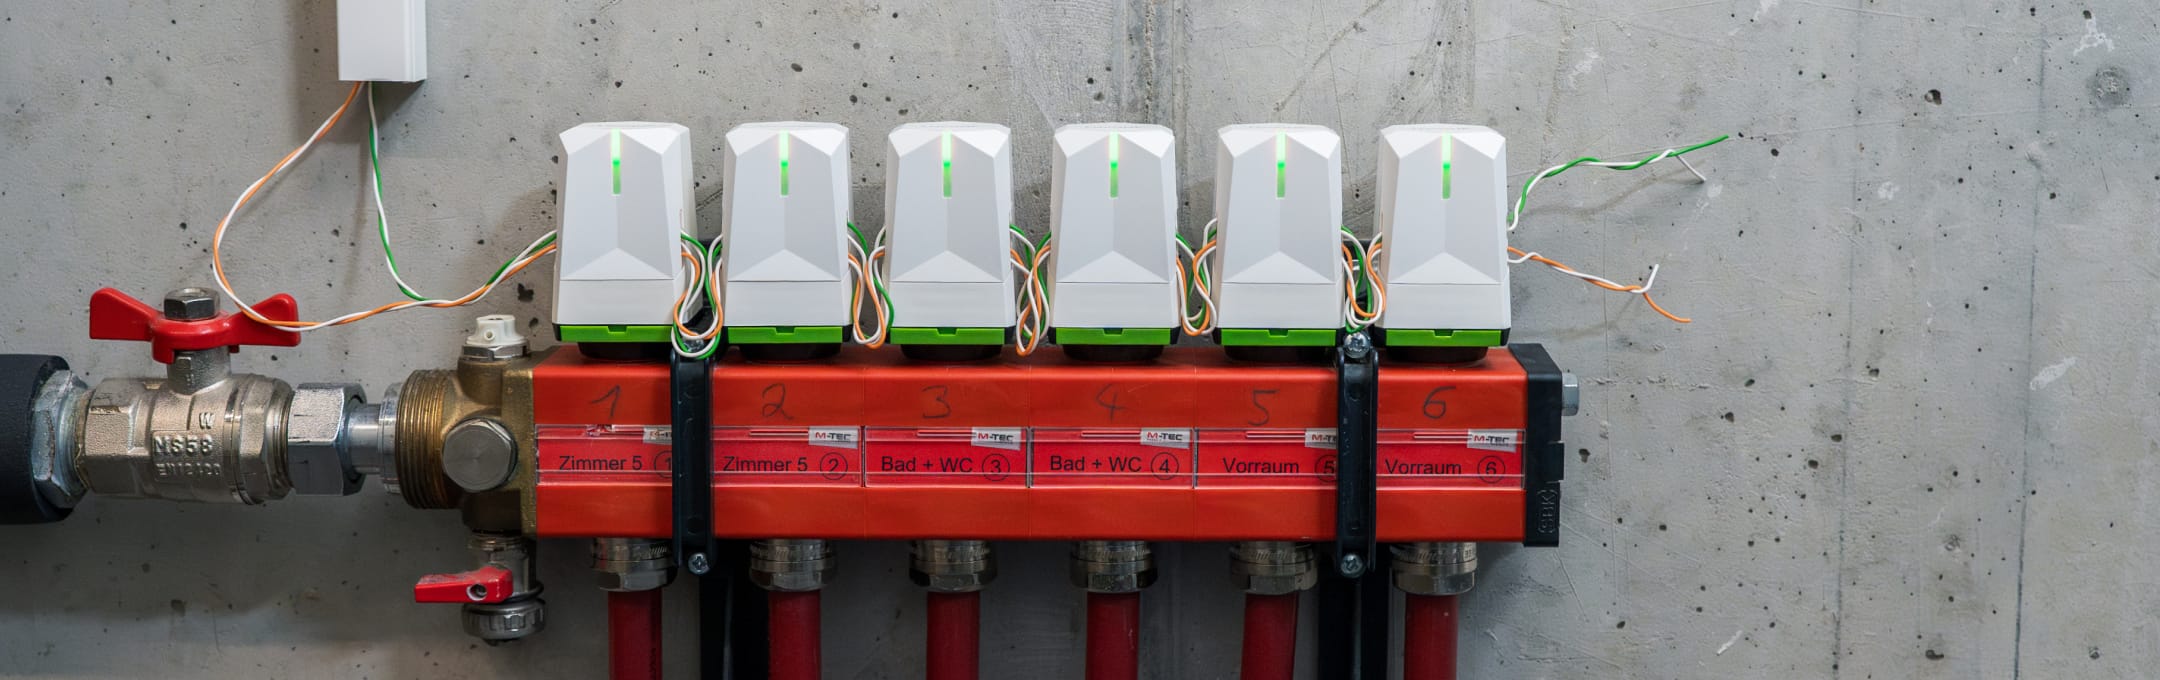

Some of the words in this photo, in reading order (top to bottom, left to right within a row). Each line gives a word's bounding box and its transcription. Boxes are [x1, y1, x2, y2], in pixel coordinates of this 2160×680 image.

[589, 385, 620, 418] 1
[762, 383, 793, 420] 2
[922, 385, 952, 418] 3
[1095, 383, 1129, 421] 4
[1248, 389, 1280, 426] 5
[1423, 386, 1456, 419] 6
[815, 431, 851, 441] M-TEC
[978, 432, 1014, 442] M-TEC
[1147, 431, 1183, 442] M-TEC
[1474, 434, 1510, 445] M-TEC
[559, 455, 626, 471] Zimmer
[632, 456, 643, 471] 5
[723, 456, 792, 472] Zimmer
[797, 457, 808, 472] 5
[881, 456, 916, 472] Bad
[923, 459, 934, 470] +
[940, 457, 973, 473] WC
[1050, 455, 1085, 471] Bad
[1092, 458, 1102, 469] +
[1109, 456, 1142, 473] WC
[1223, 457, 1299, 474] Vorraum
[1385, 458, 1462, 475] Vorraum
